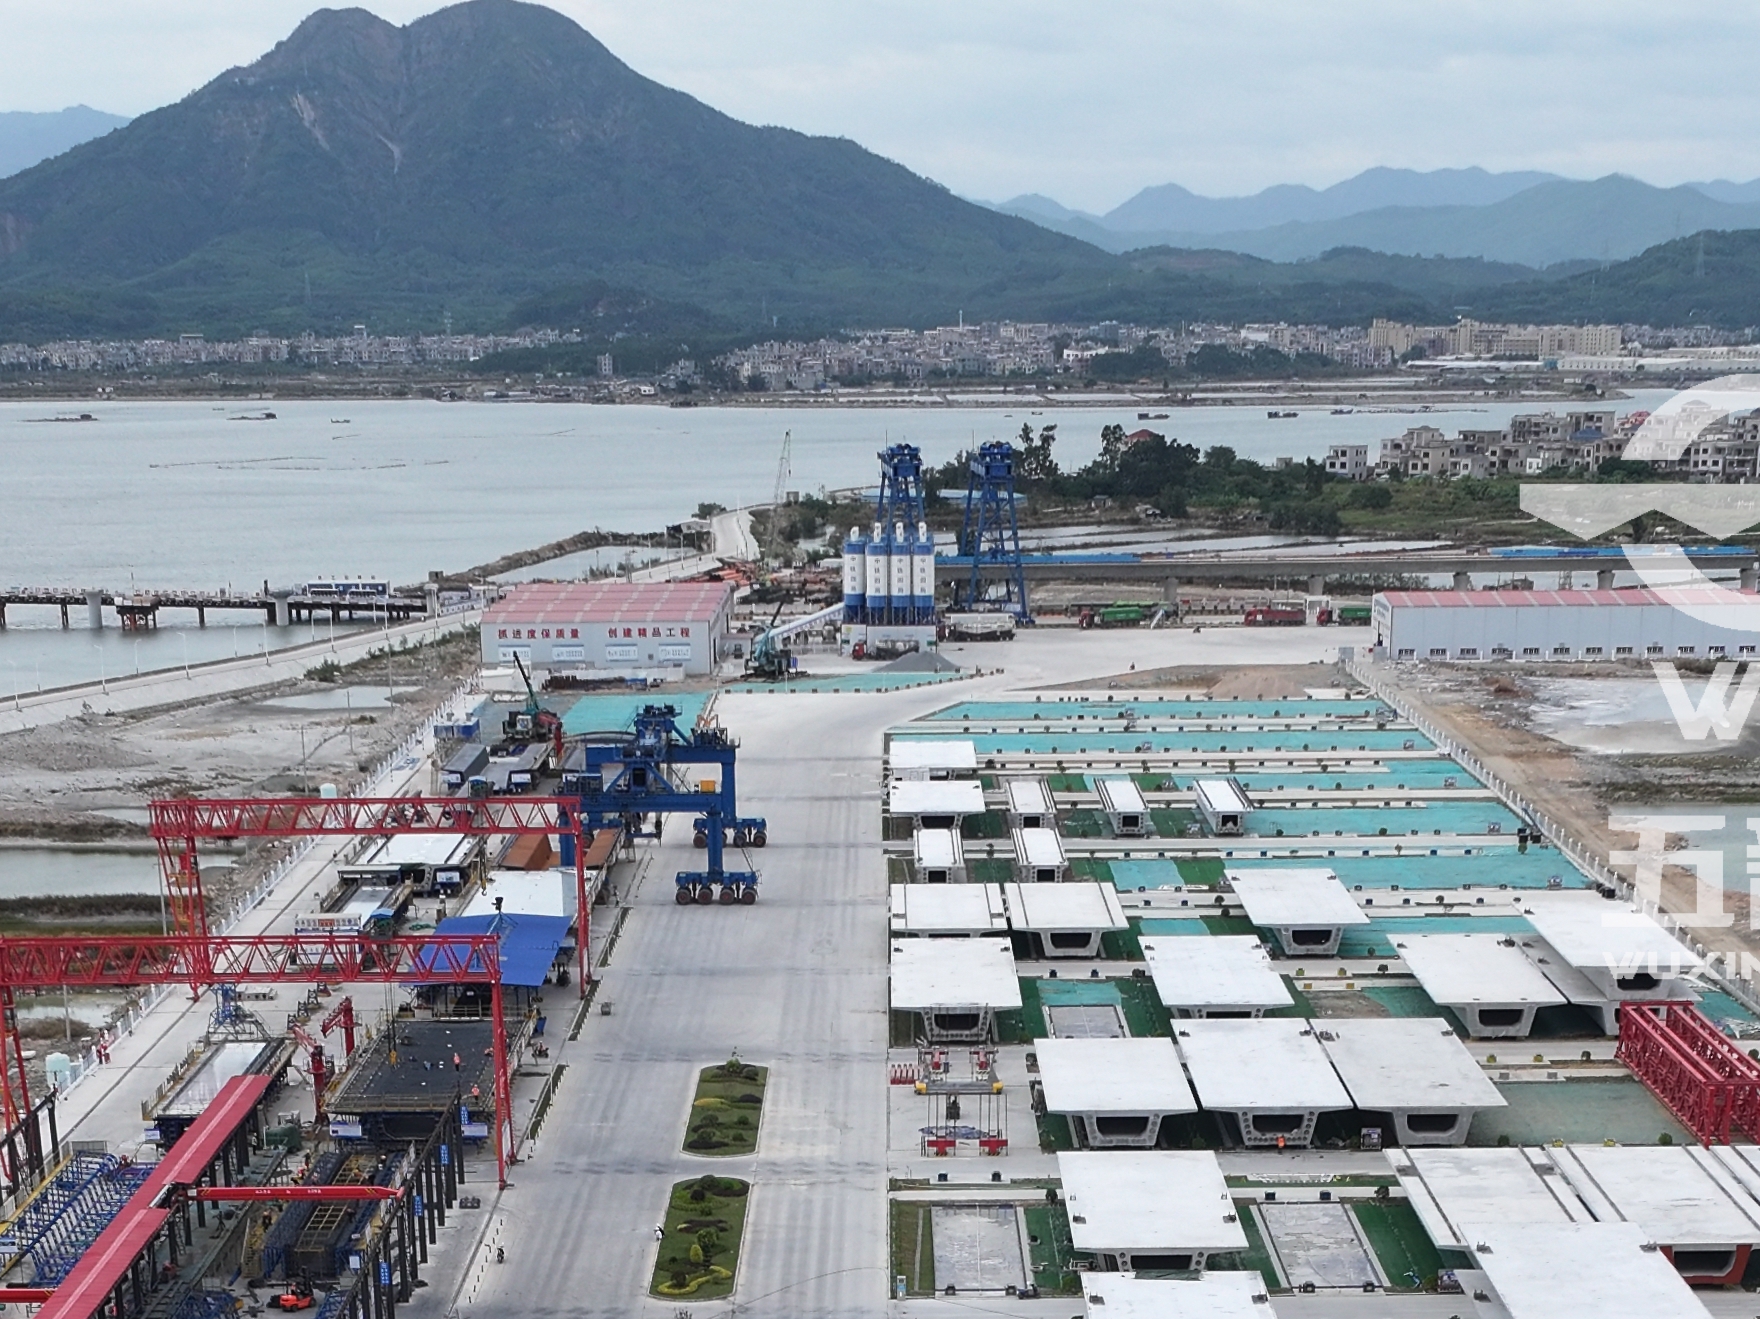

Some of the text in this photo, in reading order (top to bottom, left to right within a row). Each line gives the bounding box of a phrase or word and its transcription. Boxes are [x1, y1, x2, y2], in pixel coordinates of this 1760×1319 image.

[498, 627, 691, 639] 抓进度保质量 创建精品工程
